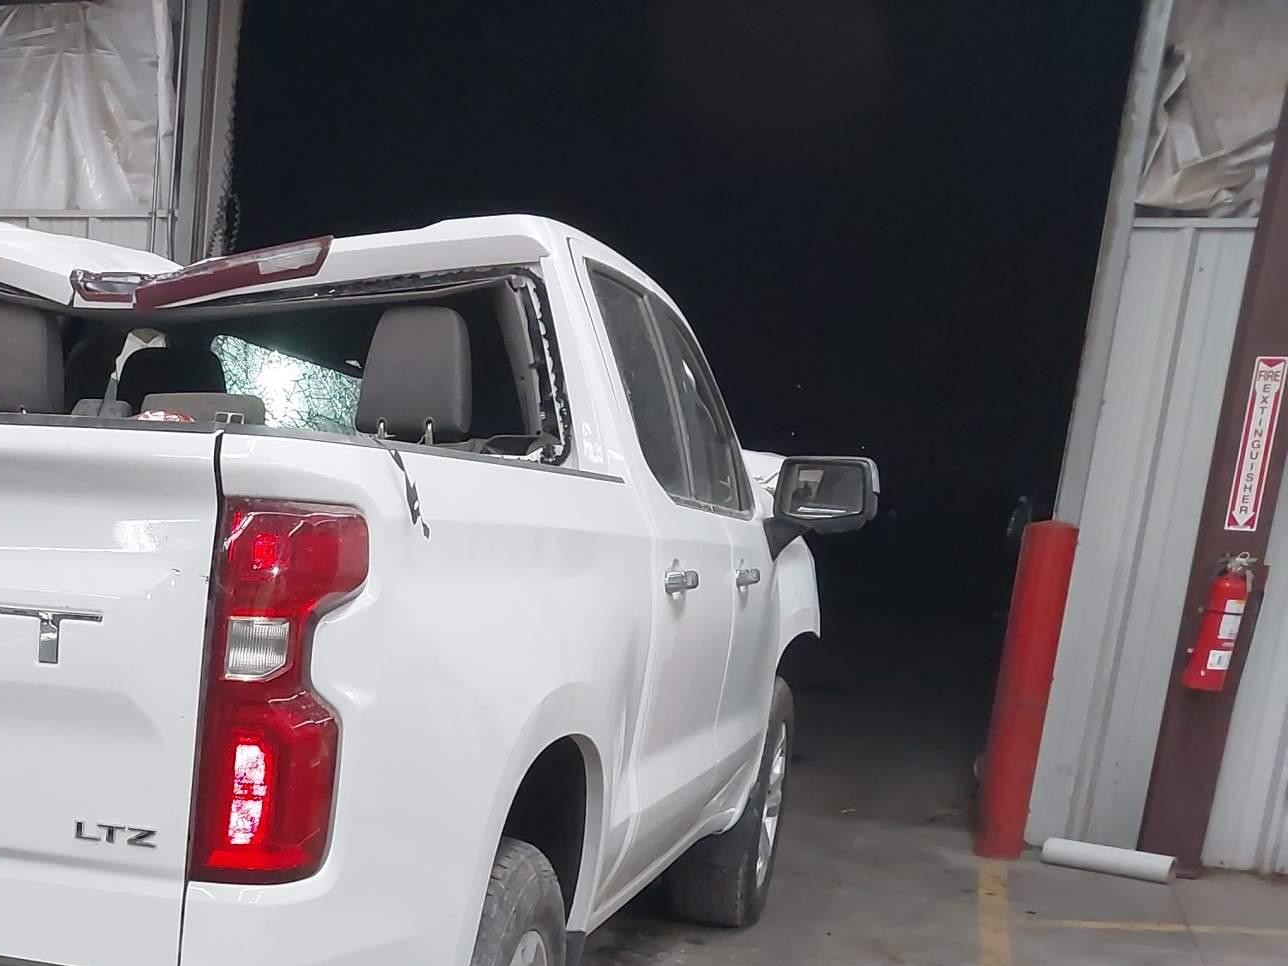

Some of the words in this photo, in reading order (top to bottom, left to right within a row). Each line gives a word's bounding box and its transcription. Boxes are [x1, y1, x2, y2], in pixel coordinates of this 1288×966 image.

[1258, 370, 1281, 382] FIRE
[1239, 383, 1272, 515] EXTINGUISHER
[75, 821, 156, 848] LTZ
